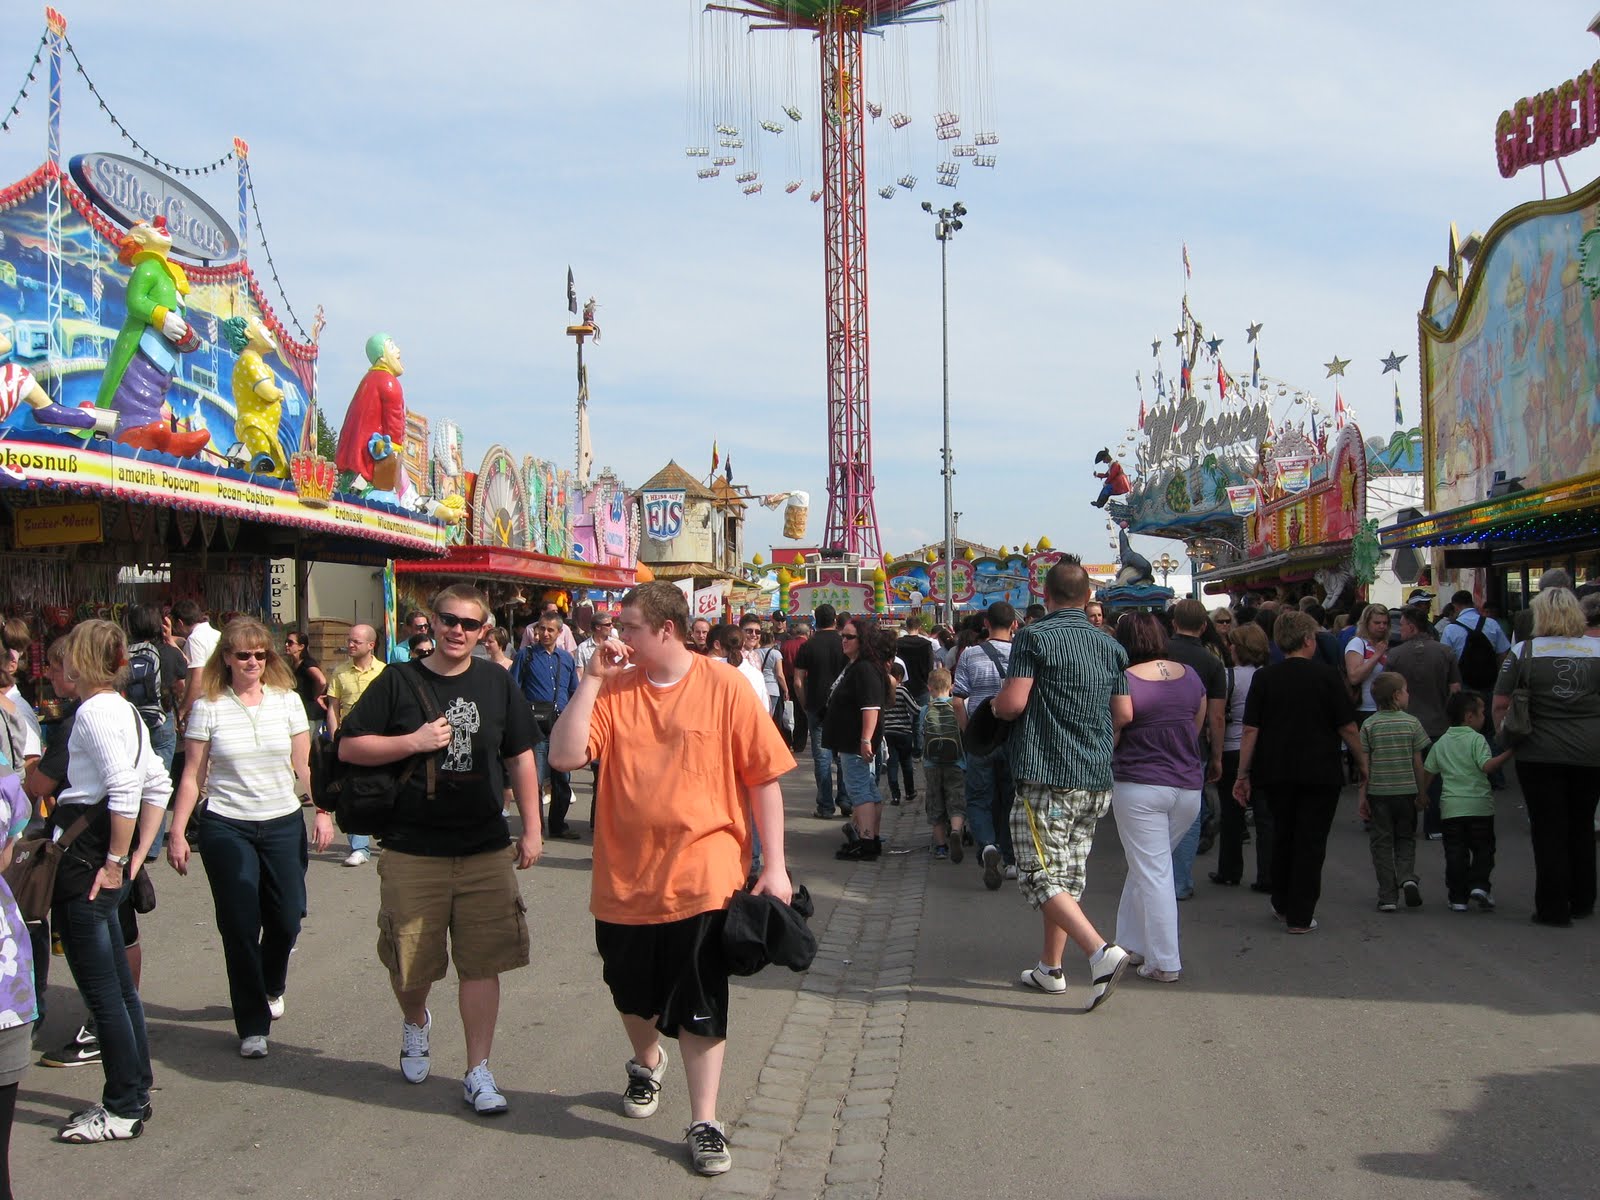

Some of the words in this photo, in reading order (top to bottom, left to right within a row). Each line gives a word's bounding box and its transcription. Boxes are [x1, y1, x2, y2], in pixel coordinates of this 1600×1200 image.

[96, 158, 165, 217] Süßer
[164, 196, 227, 257] Circus
[118, 468, 158, 486] amerik.
[162, 471, 200, 493] Popcorn
[217, 483, 275, 506] Pecan-Cashew
[335, 506, 363, 523] Erdnüsse
[645, 500, 683, 537] EIS
[698, 594, 718, 614] Eis
[812, 588, 850, 599] STAR
